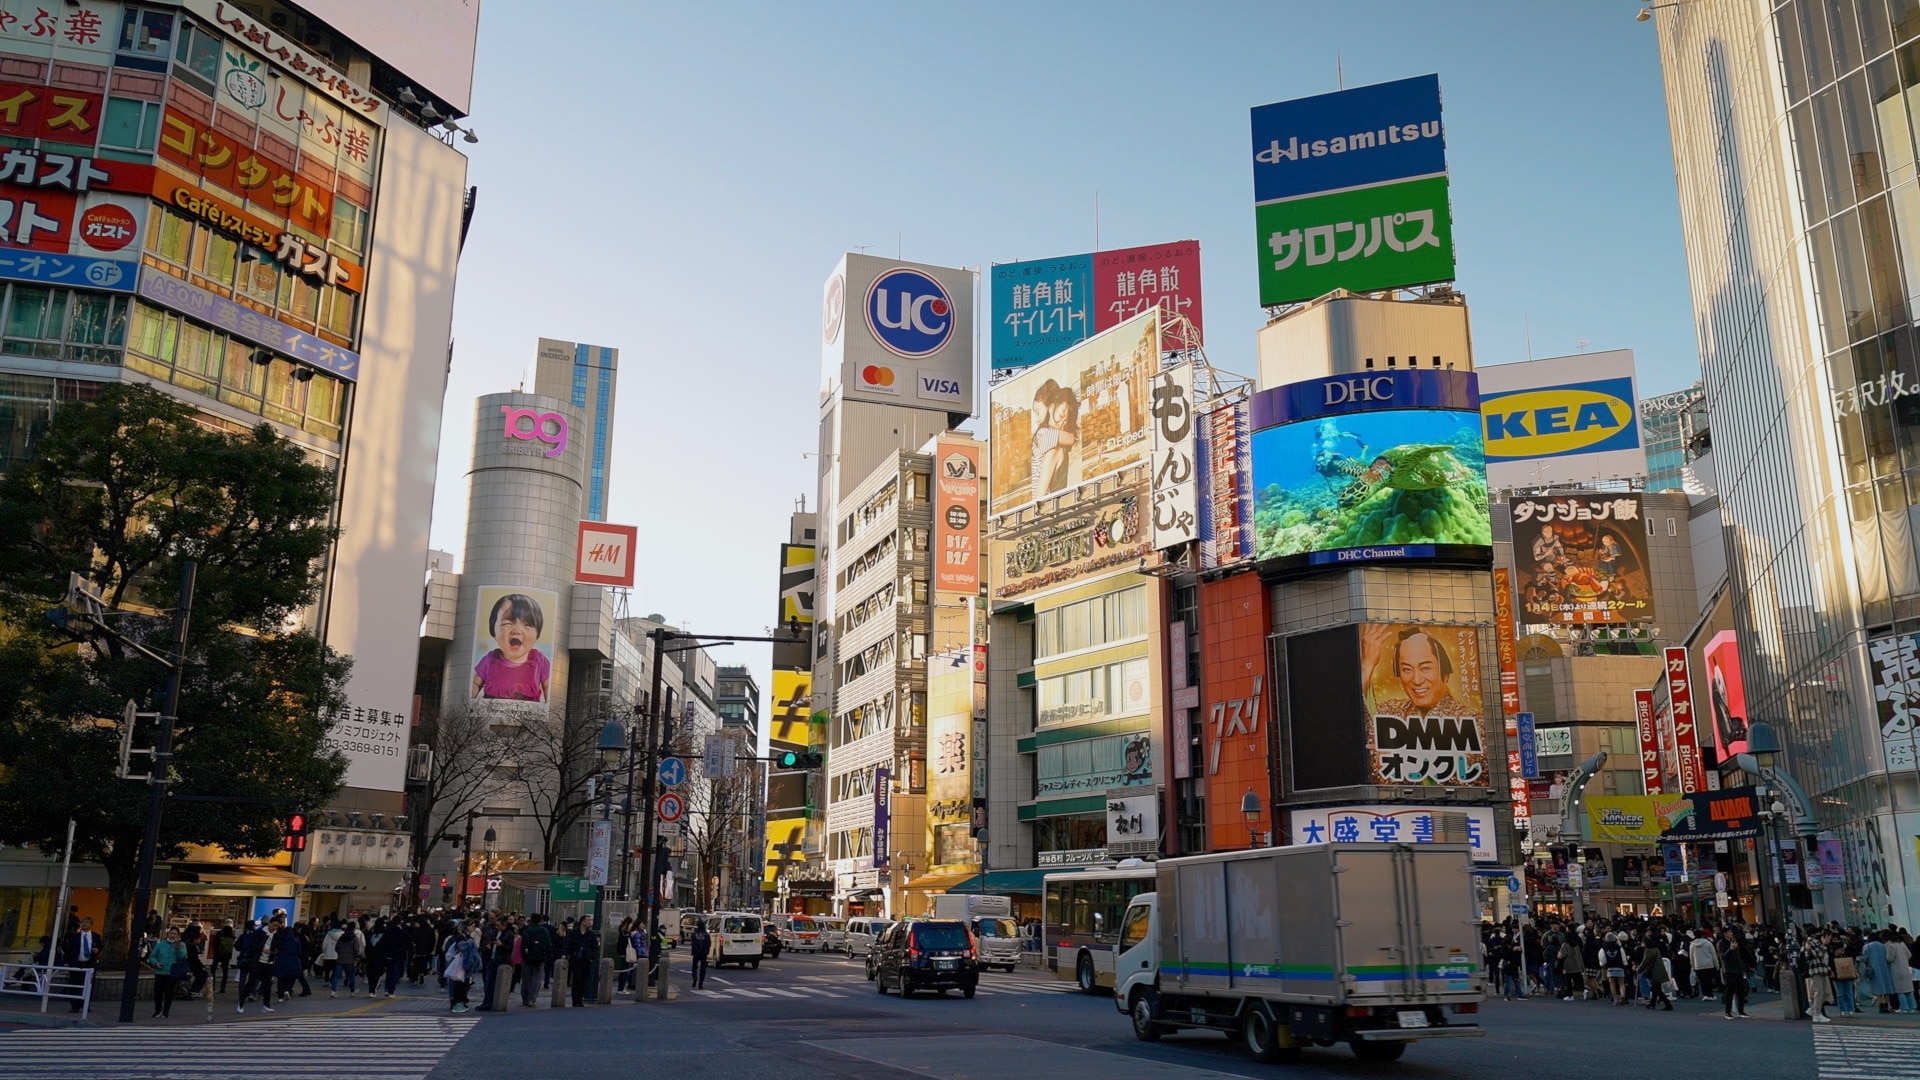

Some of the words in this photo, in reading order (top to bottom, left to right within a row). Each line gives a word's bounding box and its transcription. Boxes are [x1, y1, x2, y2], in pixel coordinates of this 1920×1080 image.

[276, 85, 370, 164] しゃぶ葉
[1256, 120, 1440, 164] Hisamitsu
[0, 150, 109, 191] ガスト
[161, 113, 326, 220] コンタクト
[86, 223, 131, 239] ガスト
[1269, 209, 1440, 271] サロンパス
[90, 264, 118, 283] 6F
[276, 233, 350, 286] ガスト
[1013, 278, 1073, 310] 龍角散
[1117, 265, 1180, 298] 龍角散
[152, 275, 206, 312] AEON
[218, 300, 283, 346] 英会話
[286, 333, 356, 372] イーオン
[876, 288, 947, 335] UC
[1004, 306, 1085, 337] ダイレクト
[540, 352, 570, 361] INDIGO
[864, 385, 894, 393] mastercard
[921, 377, 960, 395] VISA
[1324, 377, 1394, 405] DHC
[1643, 394, 1688, 413] PARCO
[501, 405, 568, 458] 109
[1486, 402, 1619, 441] KEA
[1152, 373, 1194, 537] もんじゃ
[1513, 499, 1638, 523] ダンジョン飯
[588, 543, 620, 565] H&M
[946, 534, 969, 548] B1F
[1338, 551, 1361, 560] DHC
[1363, 548, 1405, 558] Channel
[946, 551, 970, 565] B2F
[1494, 573, 1512, 664] クスリのことなら
[1468, 631, 1479, 690] クレーンゲームは
[1638, 700, 1649, 717] BIG
[1669, 658, 1693, 736] カラオケ
[1376, 717, 1481, 750] DMM
[1641, 718, 1652, 742] ECHO
[324, 738, 399, 757] 03-3369-8151
[1520, 716, 1534, 775] 大盛堂商事ビル
[1535, 744, 1571, 754] ニック
[1680, 744, 1693, 764] BIG
[1382, 755, 1479, 780] オンクレ
[1684, 766, 1696, 794] ECHO
[1710, 797, 1752, 820] ALVARK
